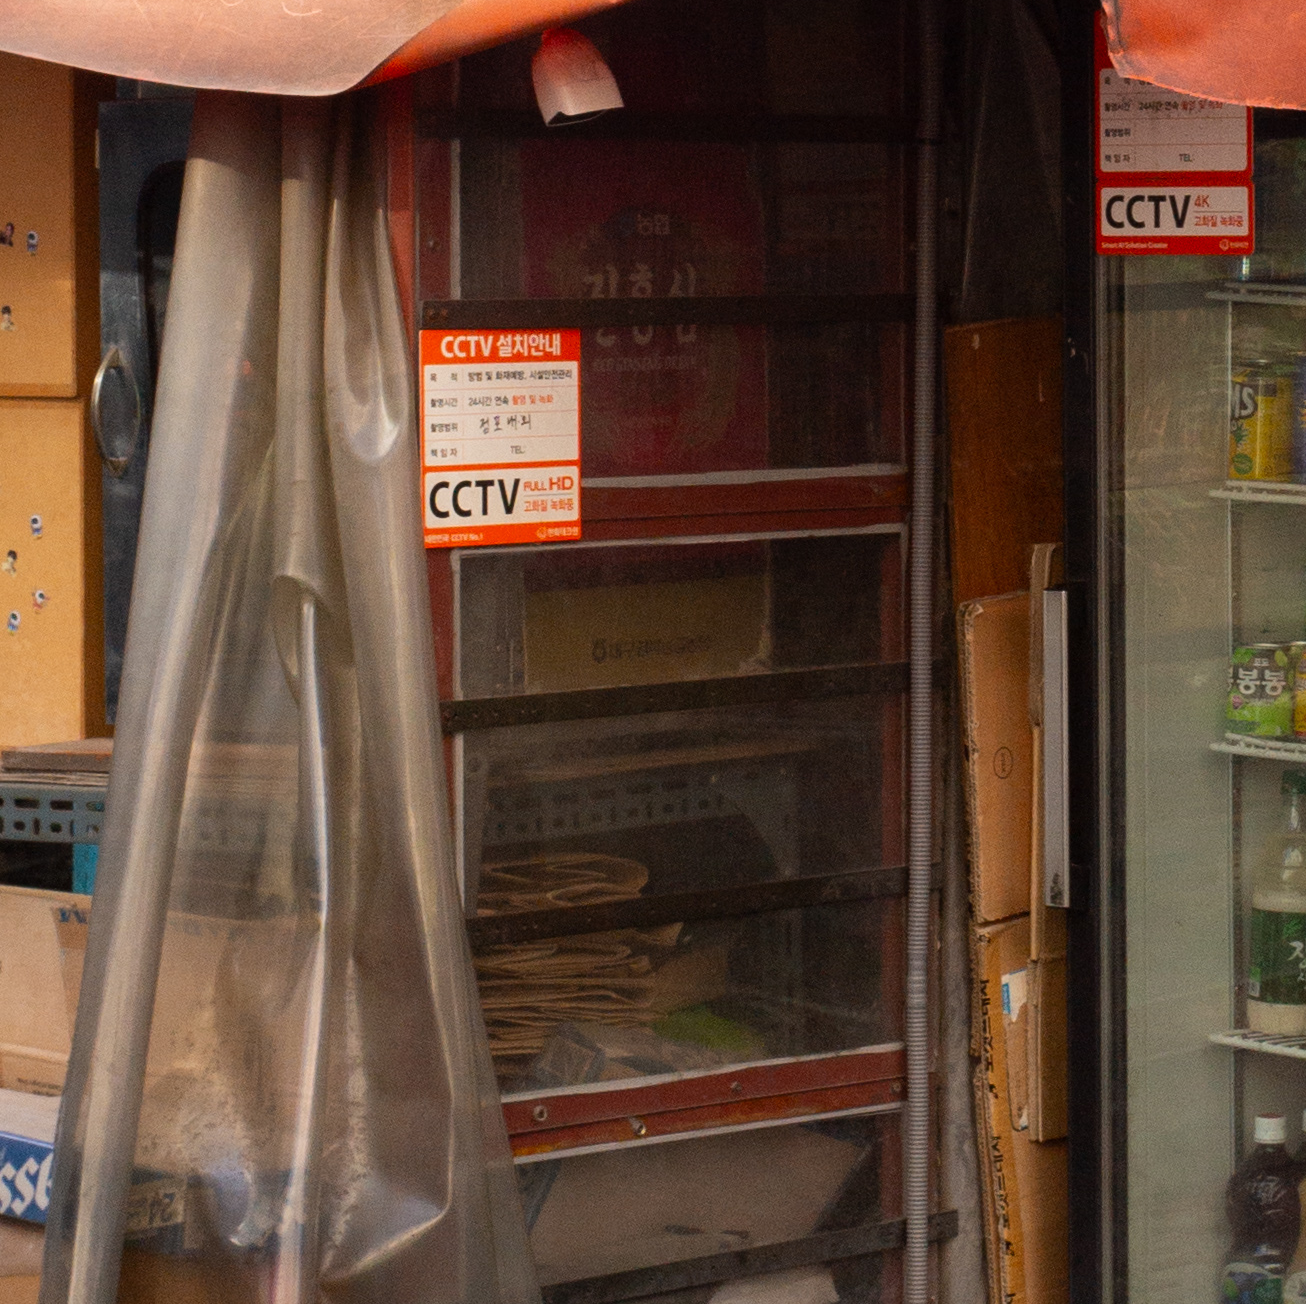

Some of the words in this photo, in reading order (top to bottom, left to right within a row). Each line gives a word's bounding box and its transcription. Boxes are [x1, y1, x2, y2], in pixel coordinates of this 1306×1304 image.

[1105, 194, 1192, 229] CCTV
[1194, 194, 1210, 208] 4K
[441, 335, 493, 358] CCTV
[496, 332, 562, 357] 설치안내
[523, 481, 548, 492] FULL
[549, 476, 575, 491] HD
[429, 478, 521, 519] CCTV
[524, 499, 548, 512] 고화질
[550, 498, 574, 512] 녹화중
